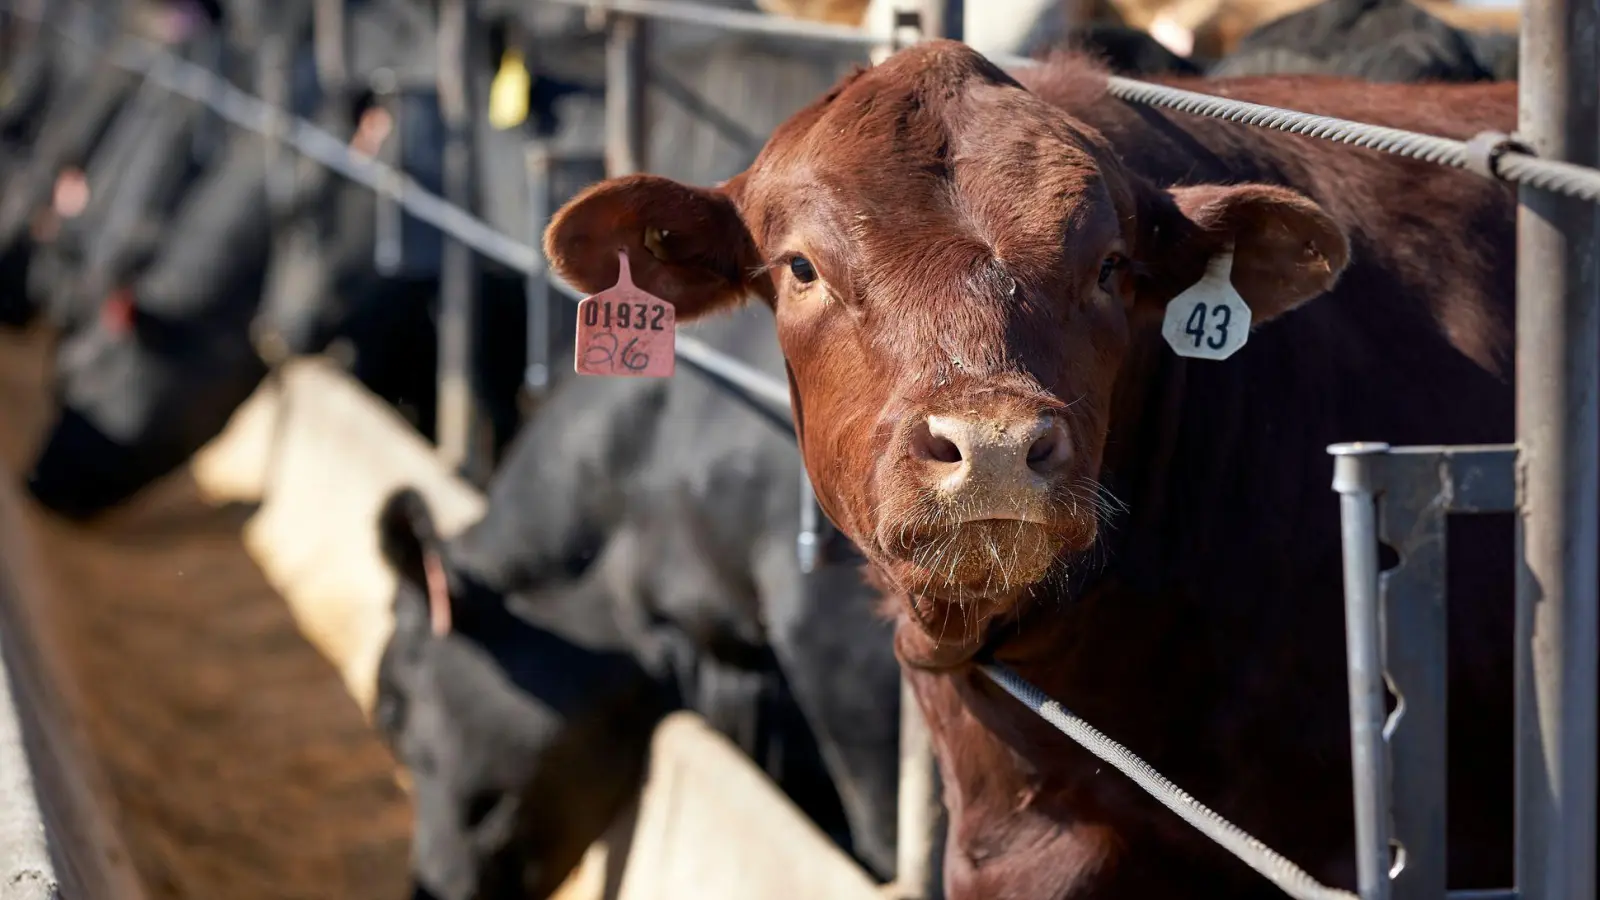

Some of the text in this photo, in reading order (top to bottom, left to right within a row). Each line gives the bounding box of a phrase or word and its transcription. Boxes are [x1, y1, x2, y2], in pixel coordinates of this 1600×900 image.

[585, 301, 665, 331] 01932
[1186, 302, 1231, 350] 43
[584, 332, 649, 371] 26
